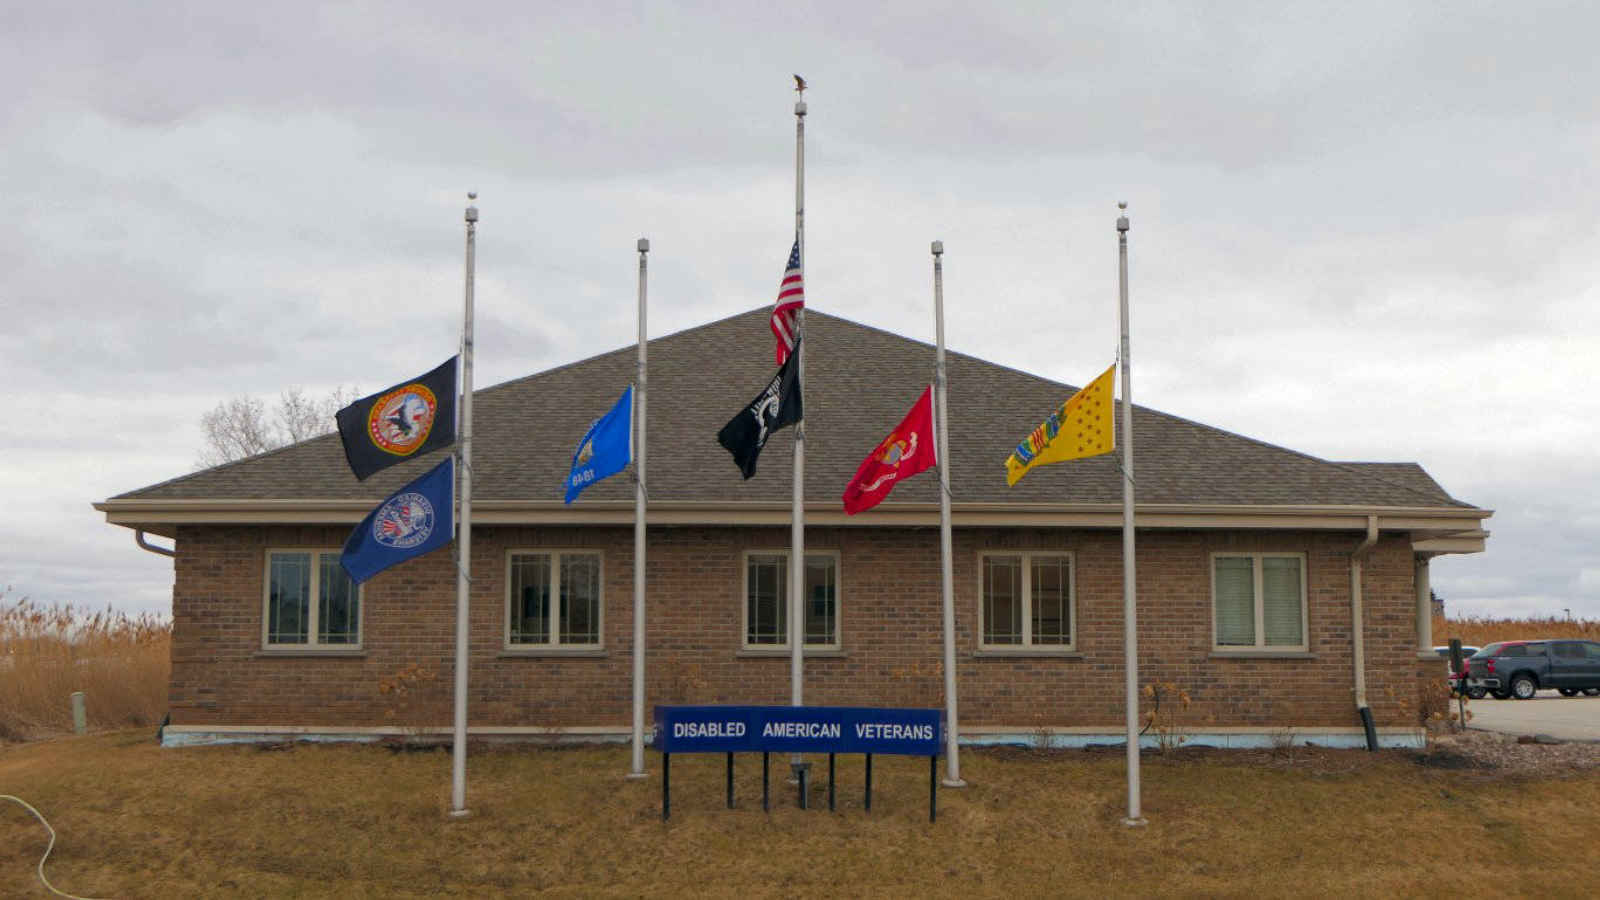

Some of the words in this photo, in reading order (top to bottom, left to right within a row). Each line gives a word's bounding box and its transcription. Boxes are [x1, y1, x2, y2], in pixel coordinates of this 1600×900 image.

[673, 722, 746, 738] DISABLED
[762, 722, 841, 738] AMERICAN
[855, 723, 933, 740] VETERANS
